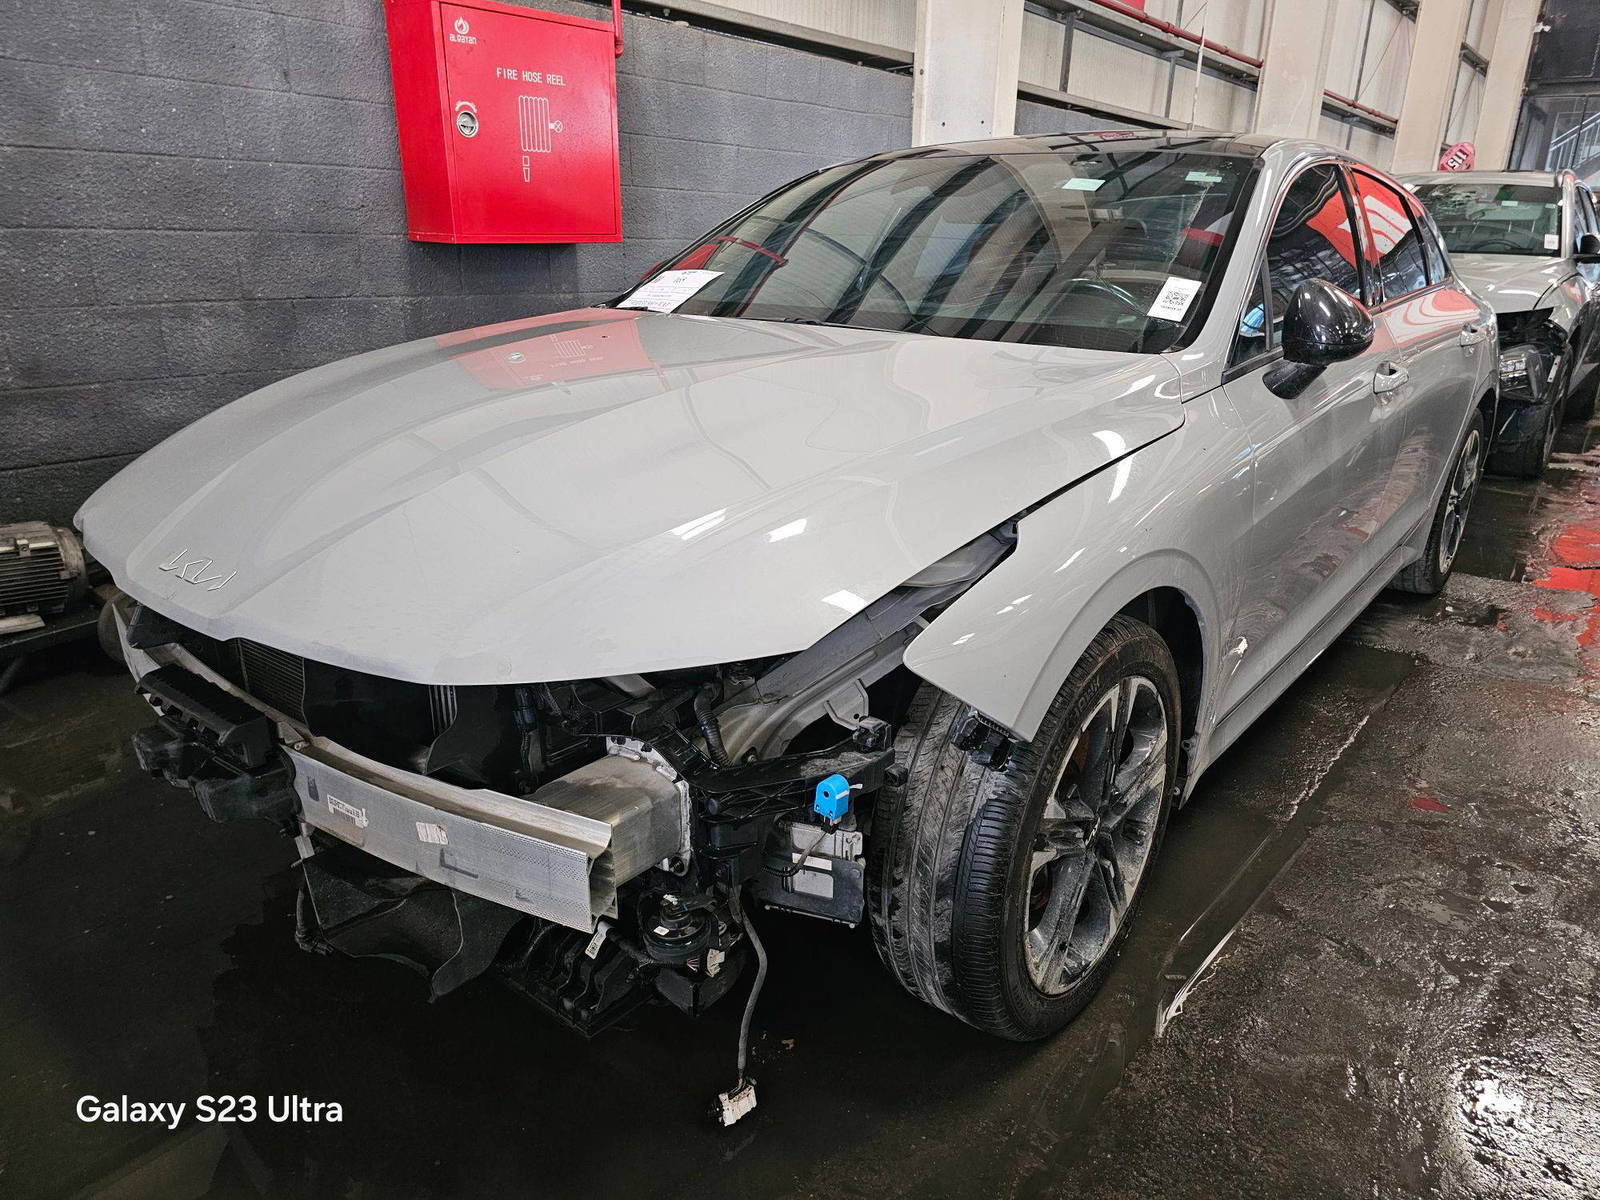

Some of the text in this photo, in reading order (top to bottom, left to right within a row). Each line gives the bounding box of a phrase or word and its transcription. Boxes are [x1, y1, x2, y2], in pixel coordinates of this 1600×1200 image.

[496, 67, 566, 87] FIRE HOSE REEL
[158, 548, 238, 592] KIA
